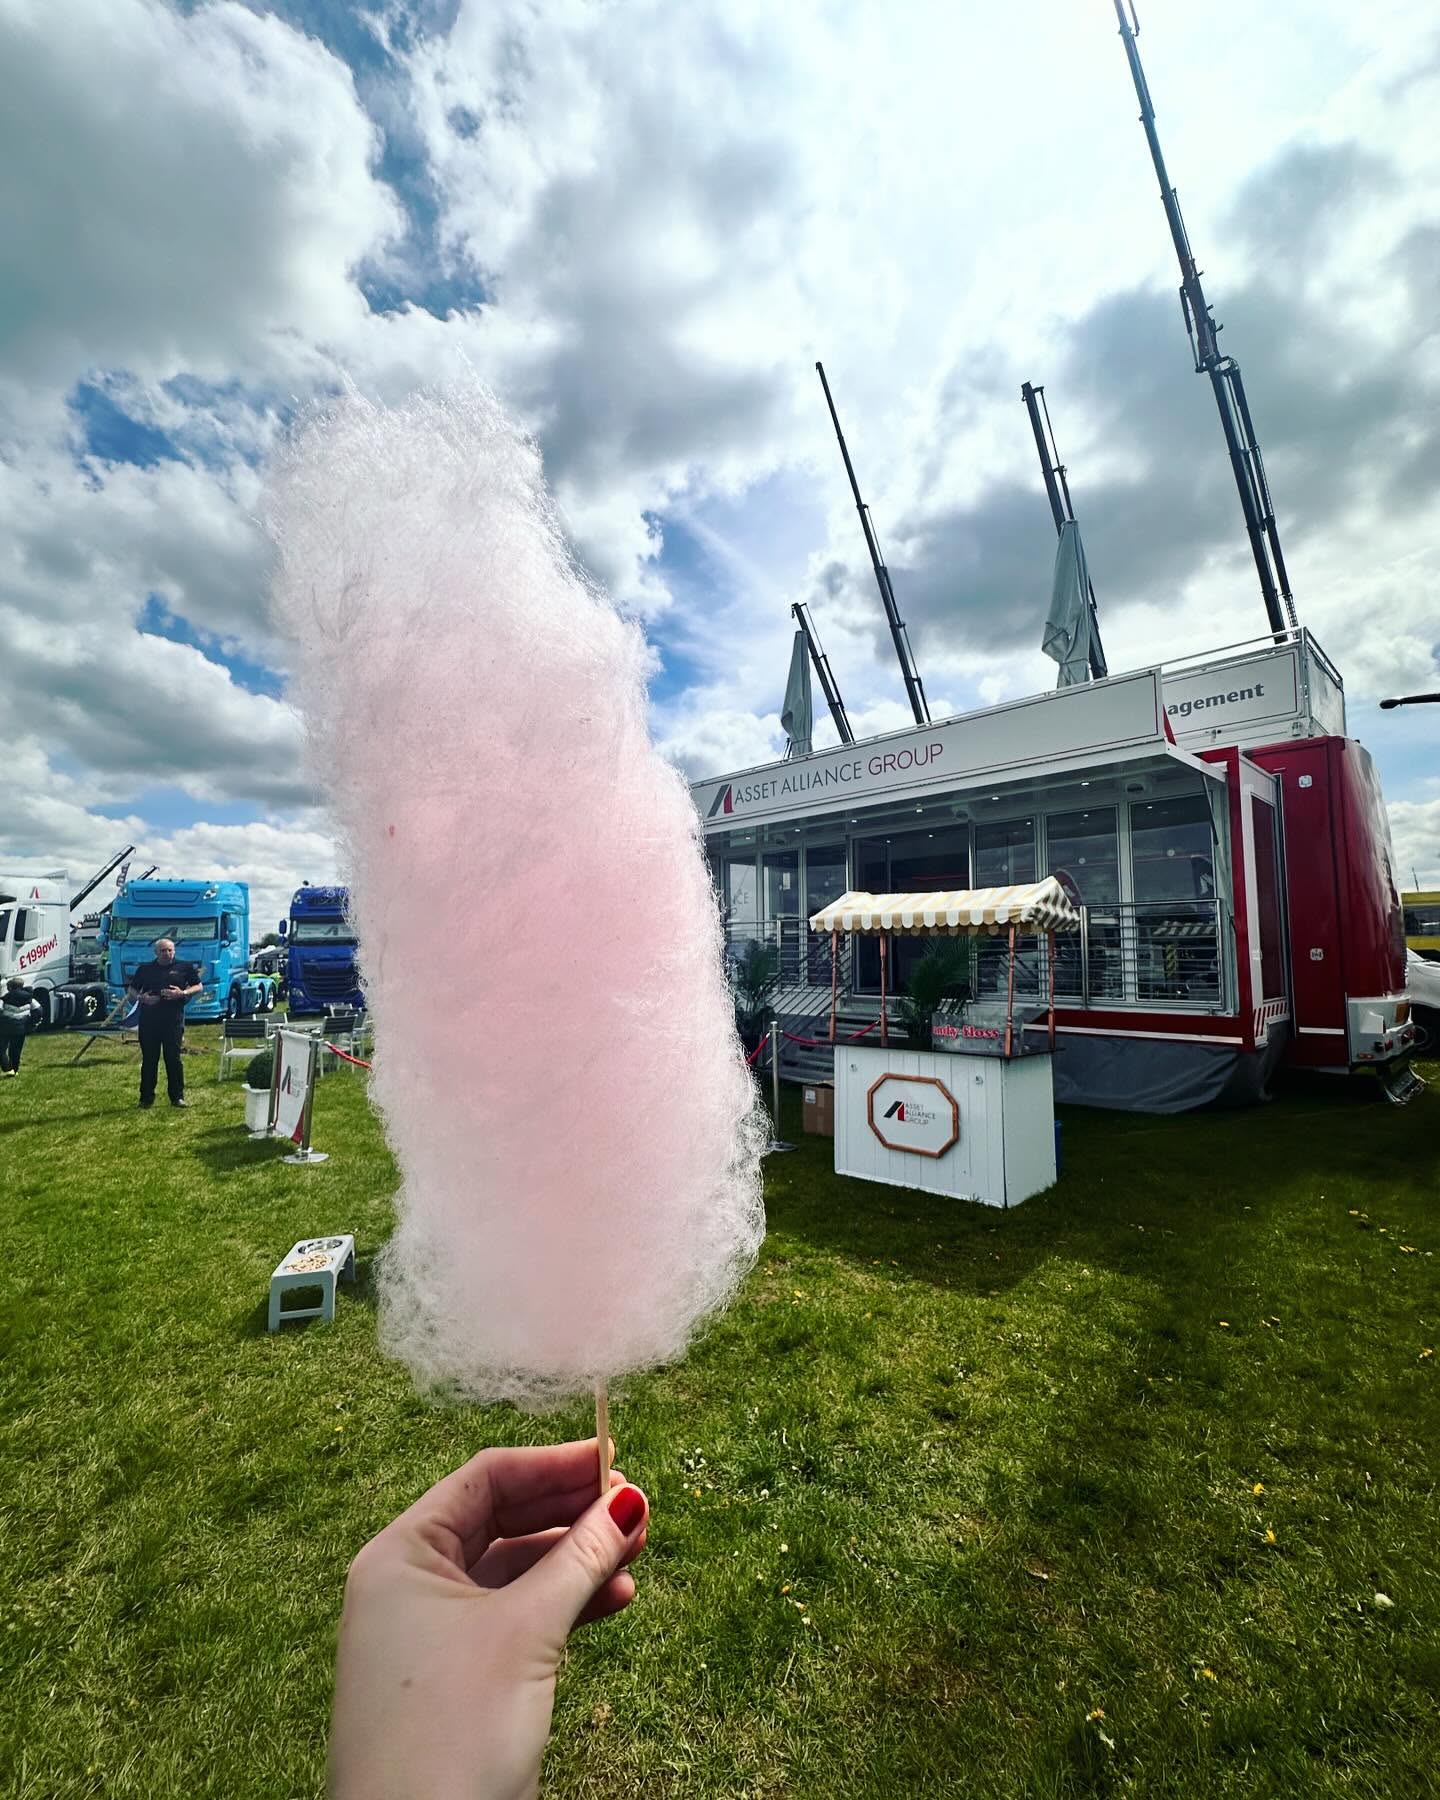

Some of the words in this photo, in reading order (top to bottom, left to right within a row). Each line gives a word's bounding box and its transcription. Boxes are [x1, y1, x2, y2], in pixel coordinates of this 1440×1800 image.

[1167, 683, 1265, 717] agement
[734, 780, 778, 805] ASSET
[780, 761, 862, 796] ALLIANCE
[868, 743, 944, 776] GROUP
[19, 934, 58, 970] £199pw!
[905, 1103, 924, 1111] ASSET
[905, 1109, 936, 1120] ALLIANCE
